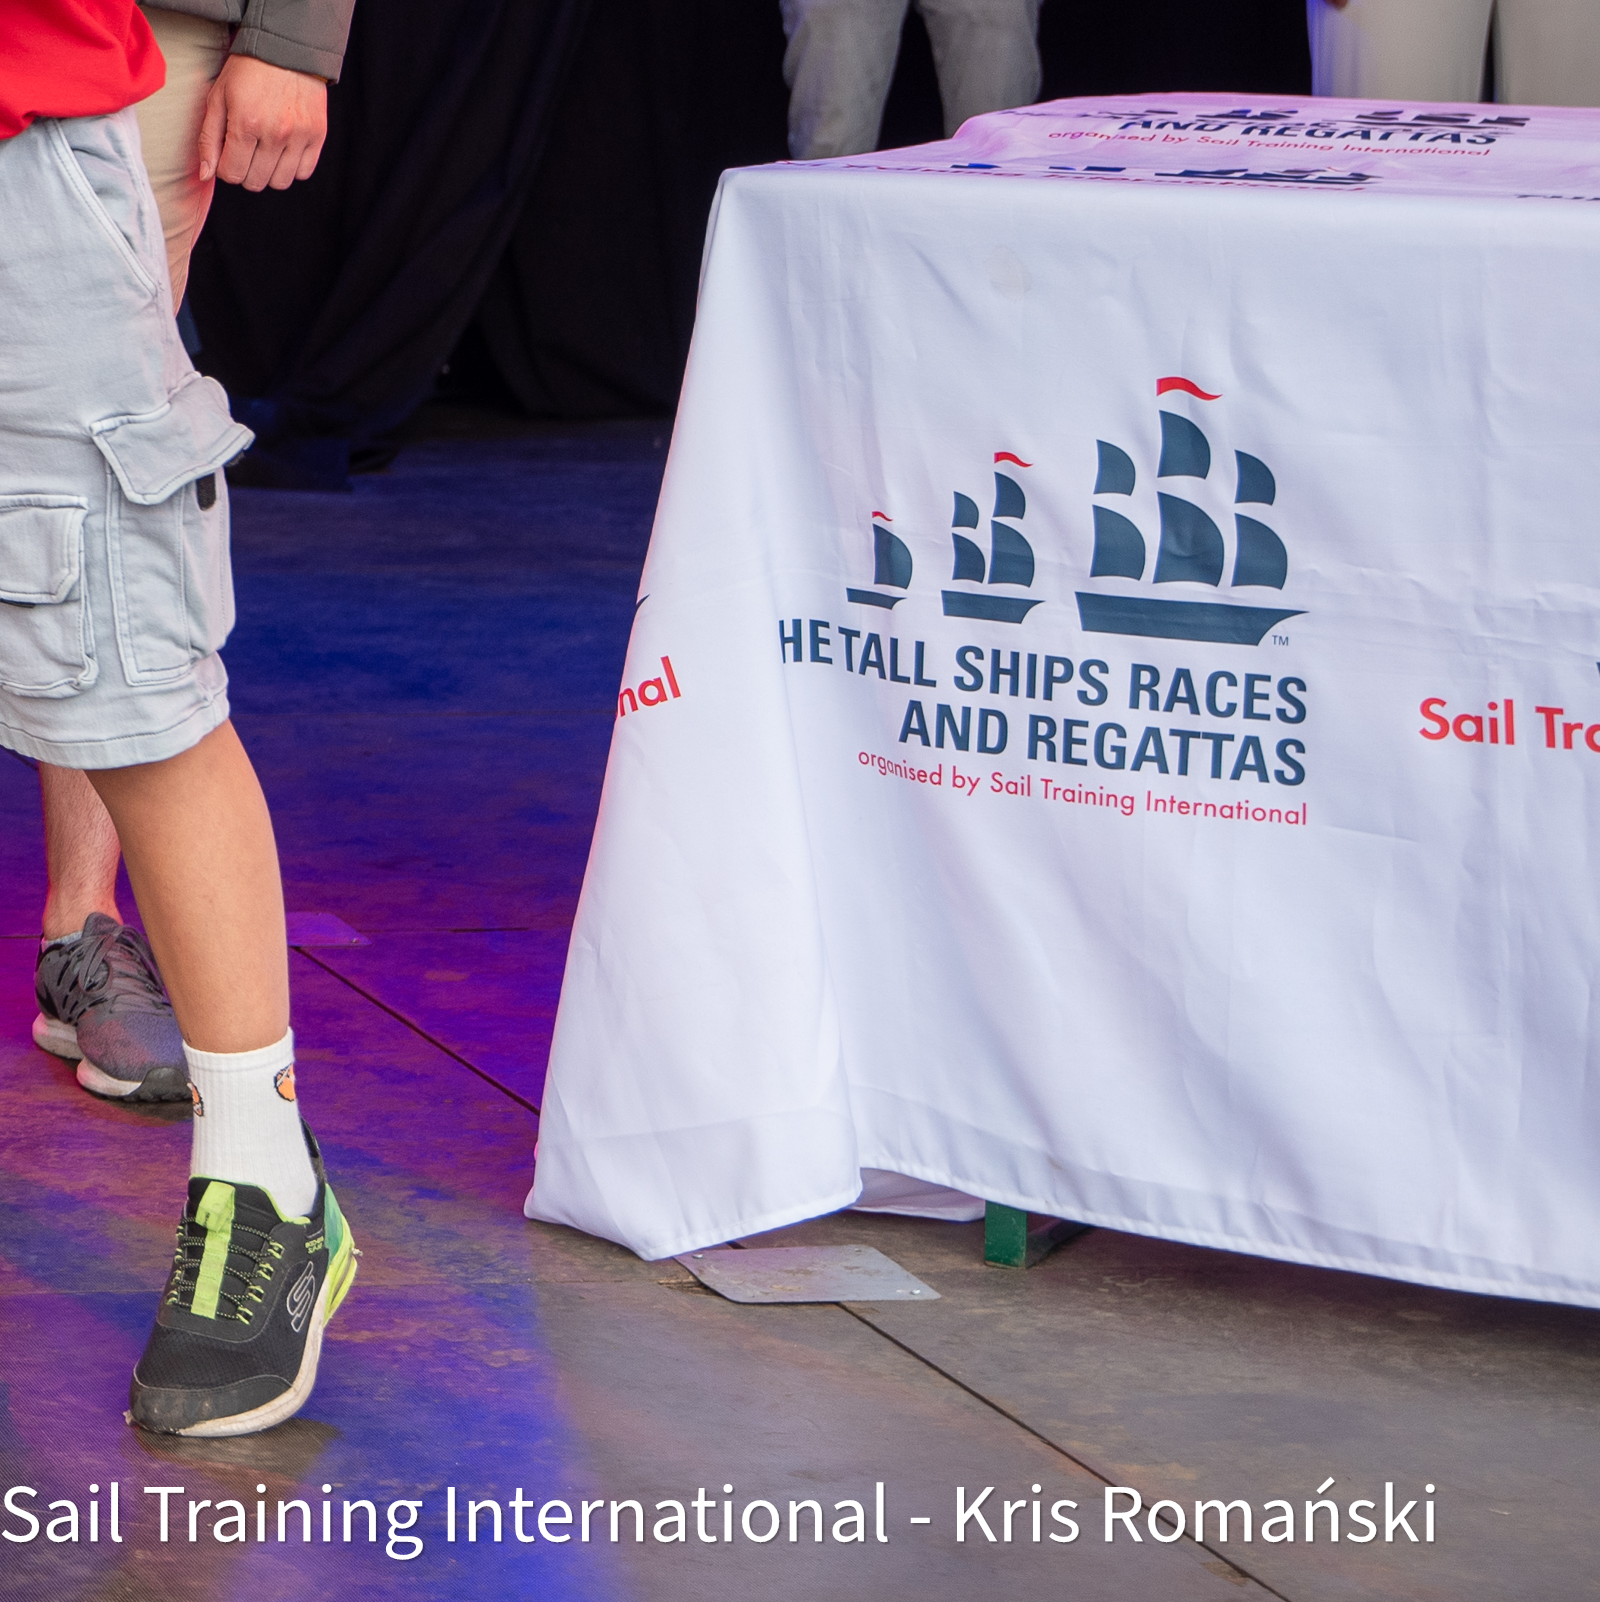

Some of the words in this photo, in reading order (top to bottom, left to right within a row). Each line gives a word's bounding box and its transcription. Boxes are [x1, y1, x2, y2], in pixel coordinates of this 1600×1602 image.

[1048, 130, 1156, 142] organised
[1161, 134, 1190, 144] by
[1197, 136, 1240, 146] Sail
[1247, 140, 1334, 151] Training
[1343, 144, 1491, 156] International
[778, 617, 834, 665] HE
[837, 625, 937, 689] TALL
[953, 645, 1110, 707] SHIPS
[1128, 662, 1308, 725] RACES
[897, 699, 1009, 756] AND
[1026, 713, 1307, 787] REGATTAS
[1418, 697, 1515, 746] Sail
[857, 751, 943, 786] organised
[951, 765, 981, 797] by
[989, 771, 1032, 798] Sail
[1040, 777, 1136, 817] Training
[1145, 789, 1308, 827] International
